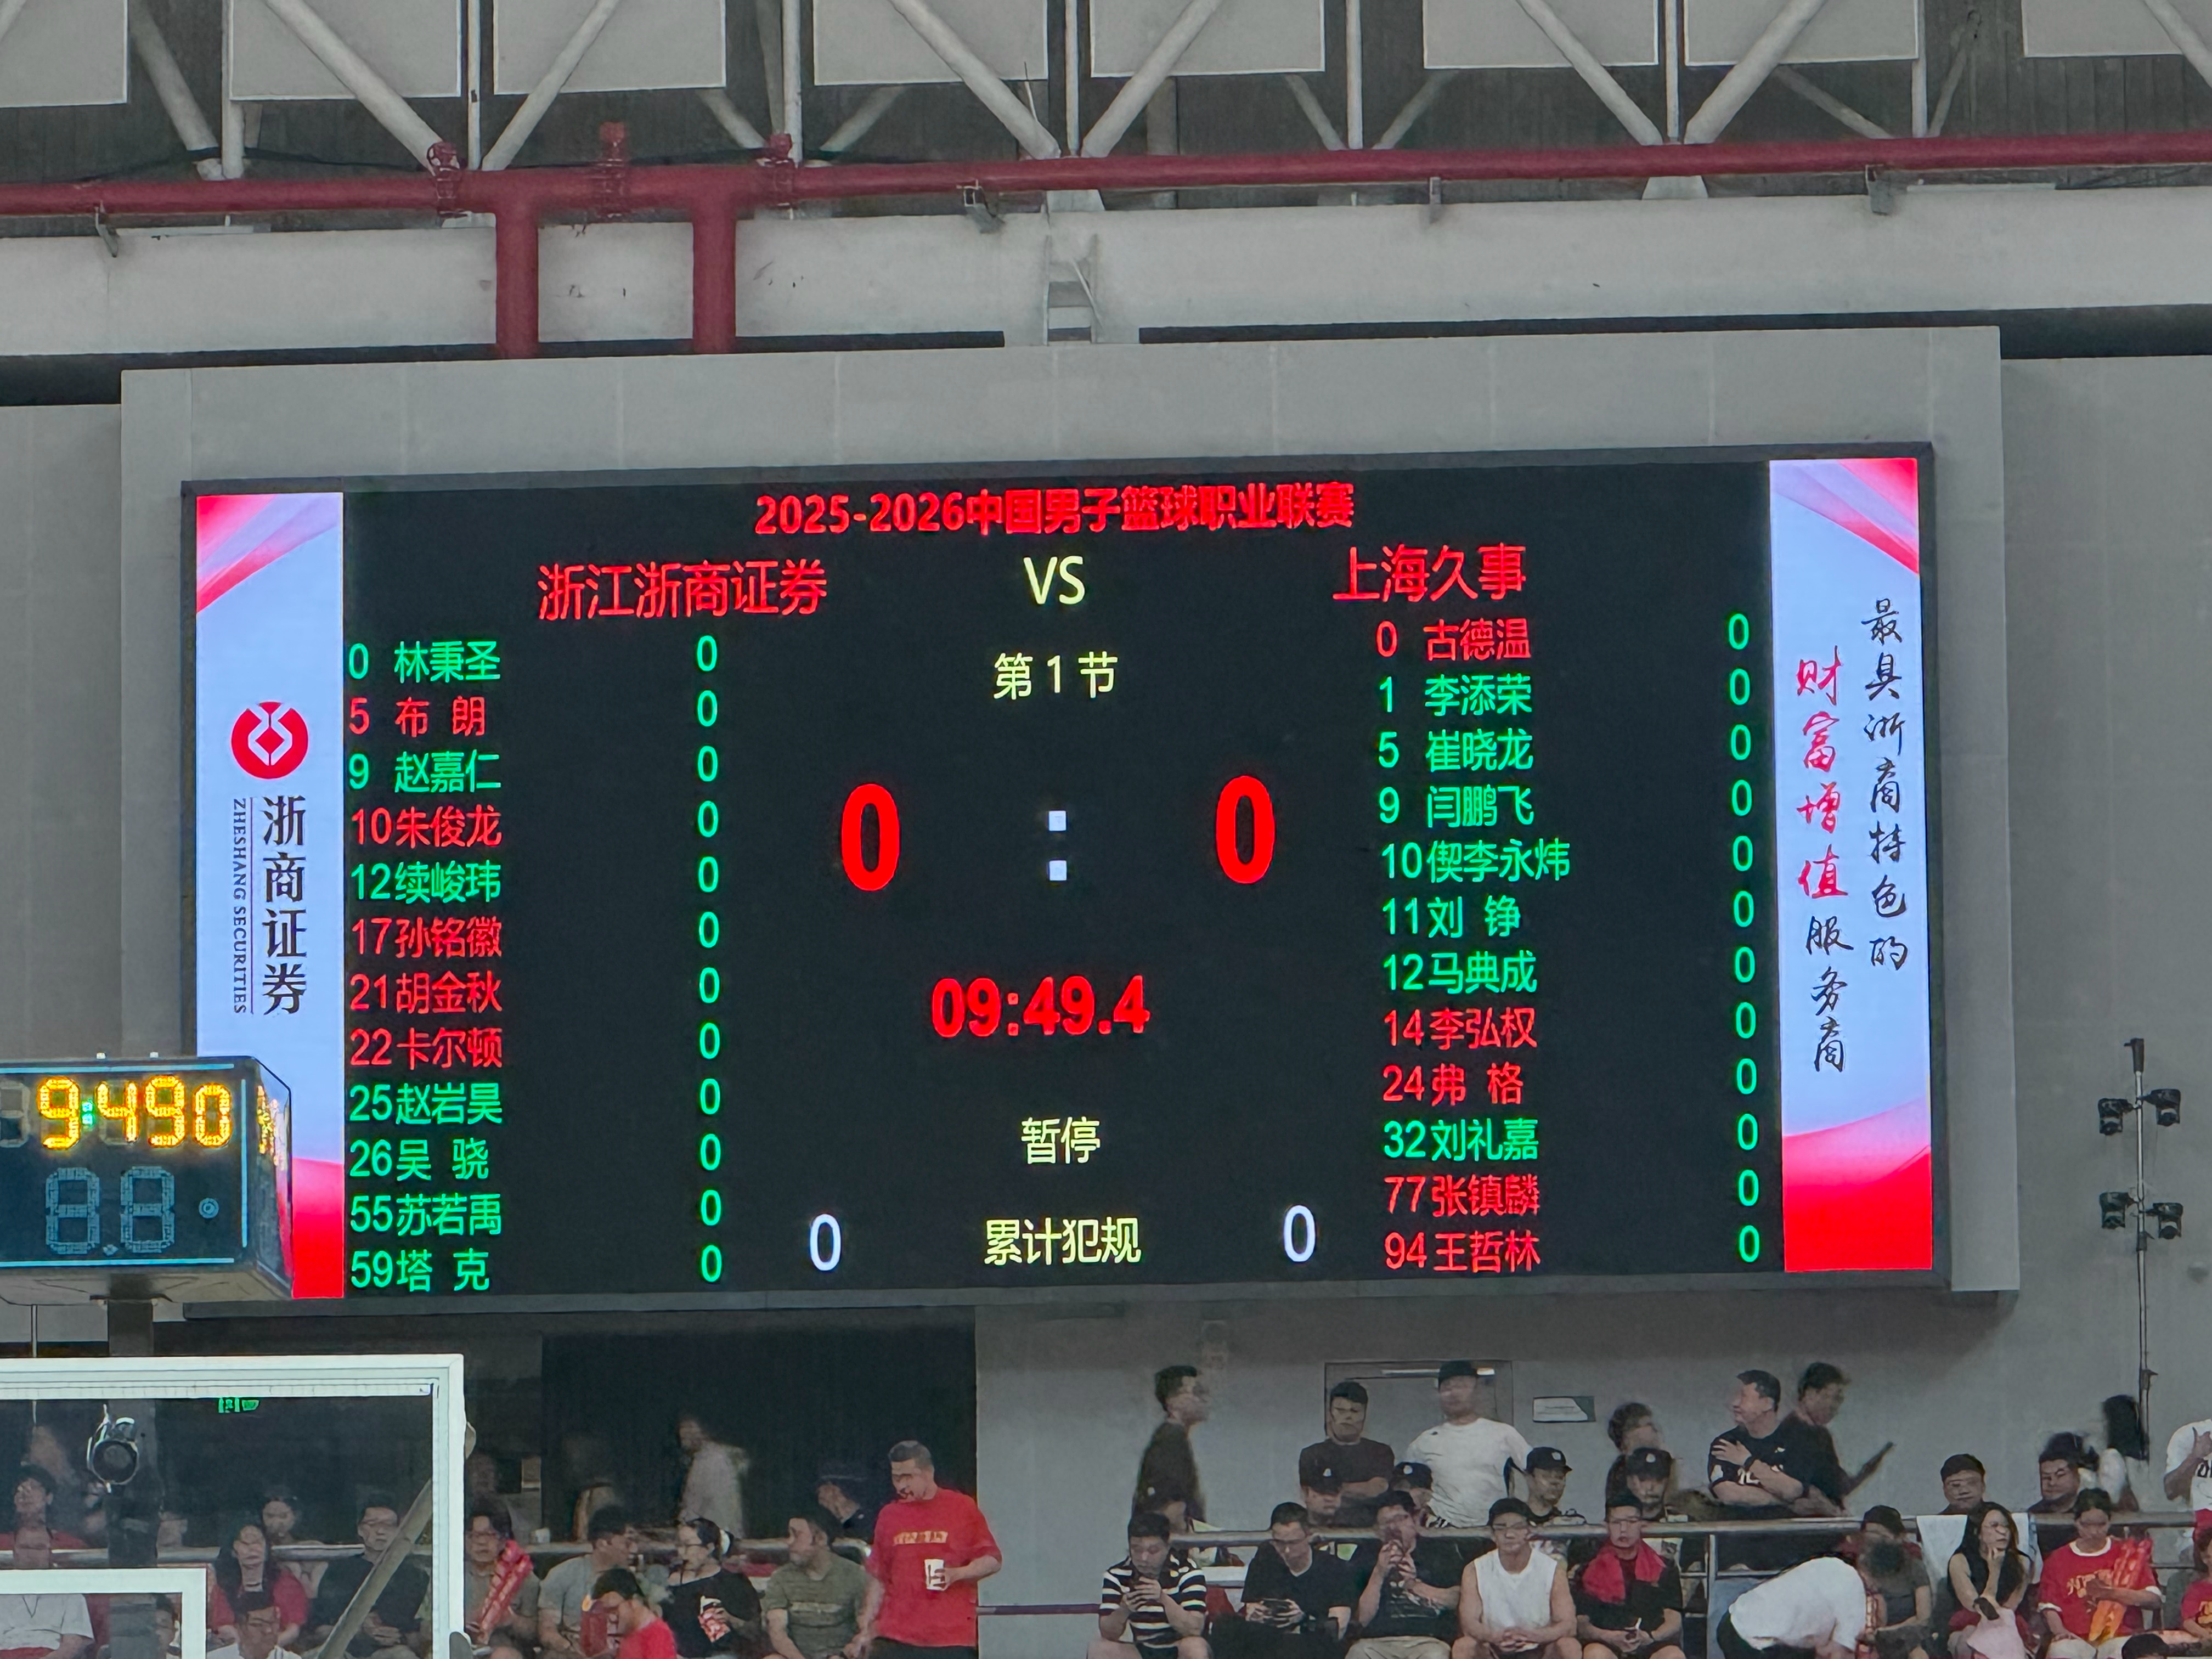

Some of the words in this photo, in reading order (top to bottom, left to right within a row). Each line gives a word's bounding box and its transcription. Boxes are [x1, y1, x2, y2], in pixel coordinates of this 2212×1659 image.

[538, 558, 827, 620] 浙江浙商证券
[1024, 556, 1085, 604] VS
[1333, 543, 1526, 602] 上海久事
[1376, 621, 1397, 657] 0
[1423, 618, 1531, 661] 古德温
[1729, 613, 1749, 650] 0
[349, 643, 368, 679] 0
[394, 641, 500, 683] 林秉圣
[697, 635, 717, 671] 0
[1380, 676, 1392, 712] 1
[1425, 673, 1532, 716] 李添荣
[1730, 669, 1750, 705] 0
[349, 697, 369, 734] 5
[697, 690, 718, 726] 0
[1379, 732, 1399, 768] 5
[1425, 728, 1533, 772] 崔晓龙
[1731, 724, 1751, 760] 0
[349, 754, 369, 789] 9
[395, 749, 501, 792] 赵嘉仁
[698, 746, 718, 781] 0
[1732, 780, 1752, 816] 0
[1861, 598, 1908, 971] 最具浙商特色的
[698, 801, 718, 837] 0
[1379, 787, 1400, 823] 9
[1427, 784, 1534, 828] 闫鹏飞
[233, 798, 247, 900] ZHESHANG
[842, 783, 900, 891] 0
[1216, 776, 1275, 884] 0
[1733, 836, 1753, 871] 0
[1796, 645, 1854, 1073] 财富增值服务商
[698, 856, 719, 892] 0
[262, 795, 307, 1015] 浙商证券
[1734, 891, 1754, 927] 0
[699, 912, 719, 948] 0
[233, 906, 247, 1013] SECURITIES
[1735, 947, 1755, 983] 0
[699, 967, 719, 1003] 0
[932, 975, 1150, 1038] 09:49.4
[1736, 1002, 1756, 1039] 0
[699, 1023, 720, 1059] 0
[1736, 1058, 1757, 1094] 0
[700, 1079, 720, 1114] 0
[1022, 1116, 1100, 1164] 暂停
[1738, 1114, 1758, 1150] 0
[700, 1133, 721, 1170] 0
[1739, 1170, 1759, 1206] 0
[701, 1190, 721, 1226] 0
[810, 1214, 841, 1271] 0
[985, 1217, 1141, 1265] 累计犯规
[1283, 1205, 1316, 1262] 0
[1739, 1225, 1759, 1262] 0
[701, 1245, 722, 1282] 0
